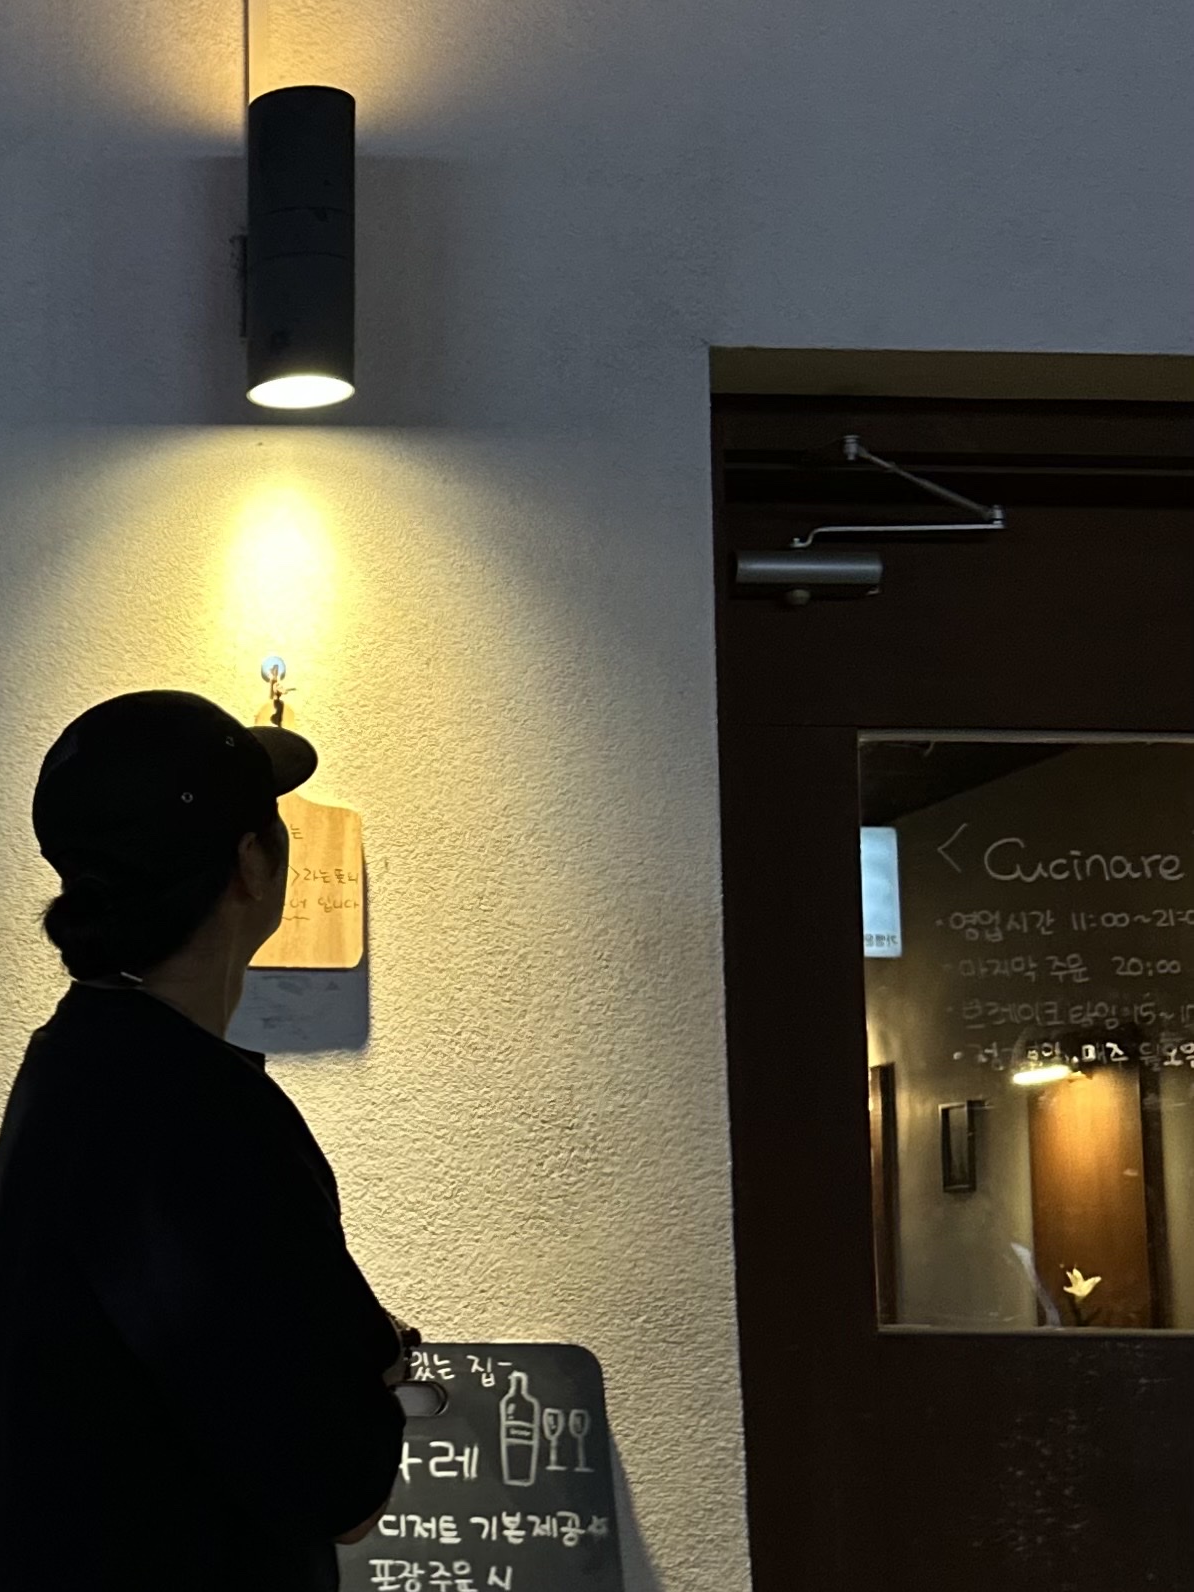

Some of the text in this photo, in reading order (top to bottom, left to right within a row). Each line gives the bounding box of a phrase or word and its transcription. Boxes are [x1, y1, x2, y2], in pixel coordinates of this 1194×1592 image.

[984, 837, 1185, 883] Cucinare
[949, 908, 1056, 942] 영업시간
[960, 953, 1182, 983] 마지막 주문 20:00
[377, 1510, 587, 1548] 디저트 기본제공
[487, 1565, 514, 1591] 시
